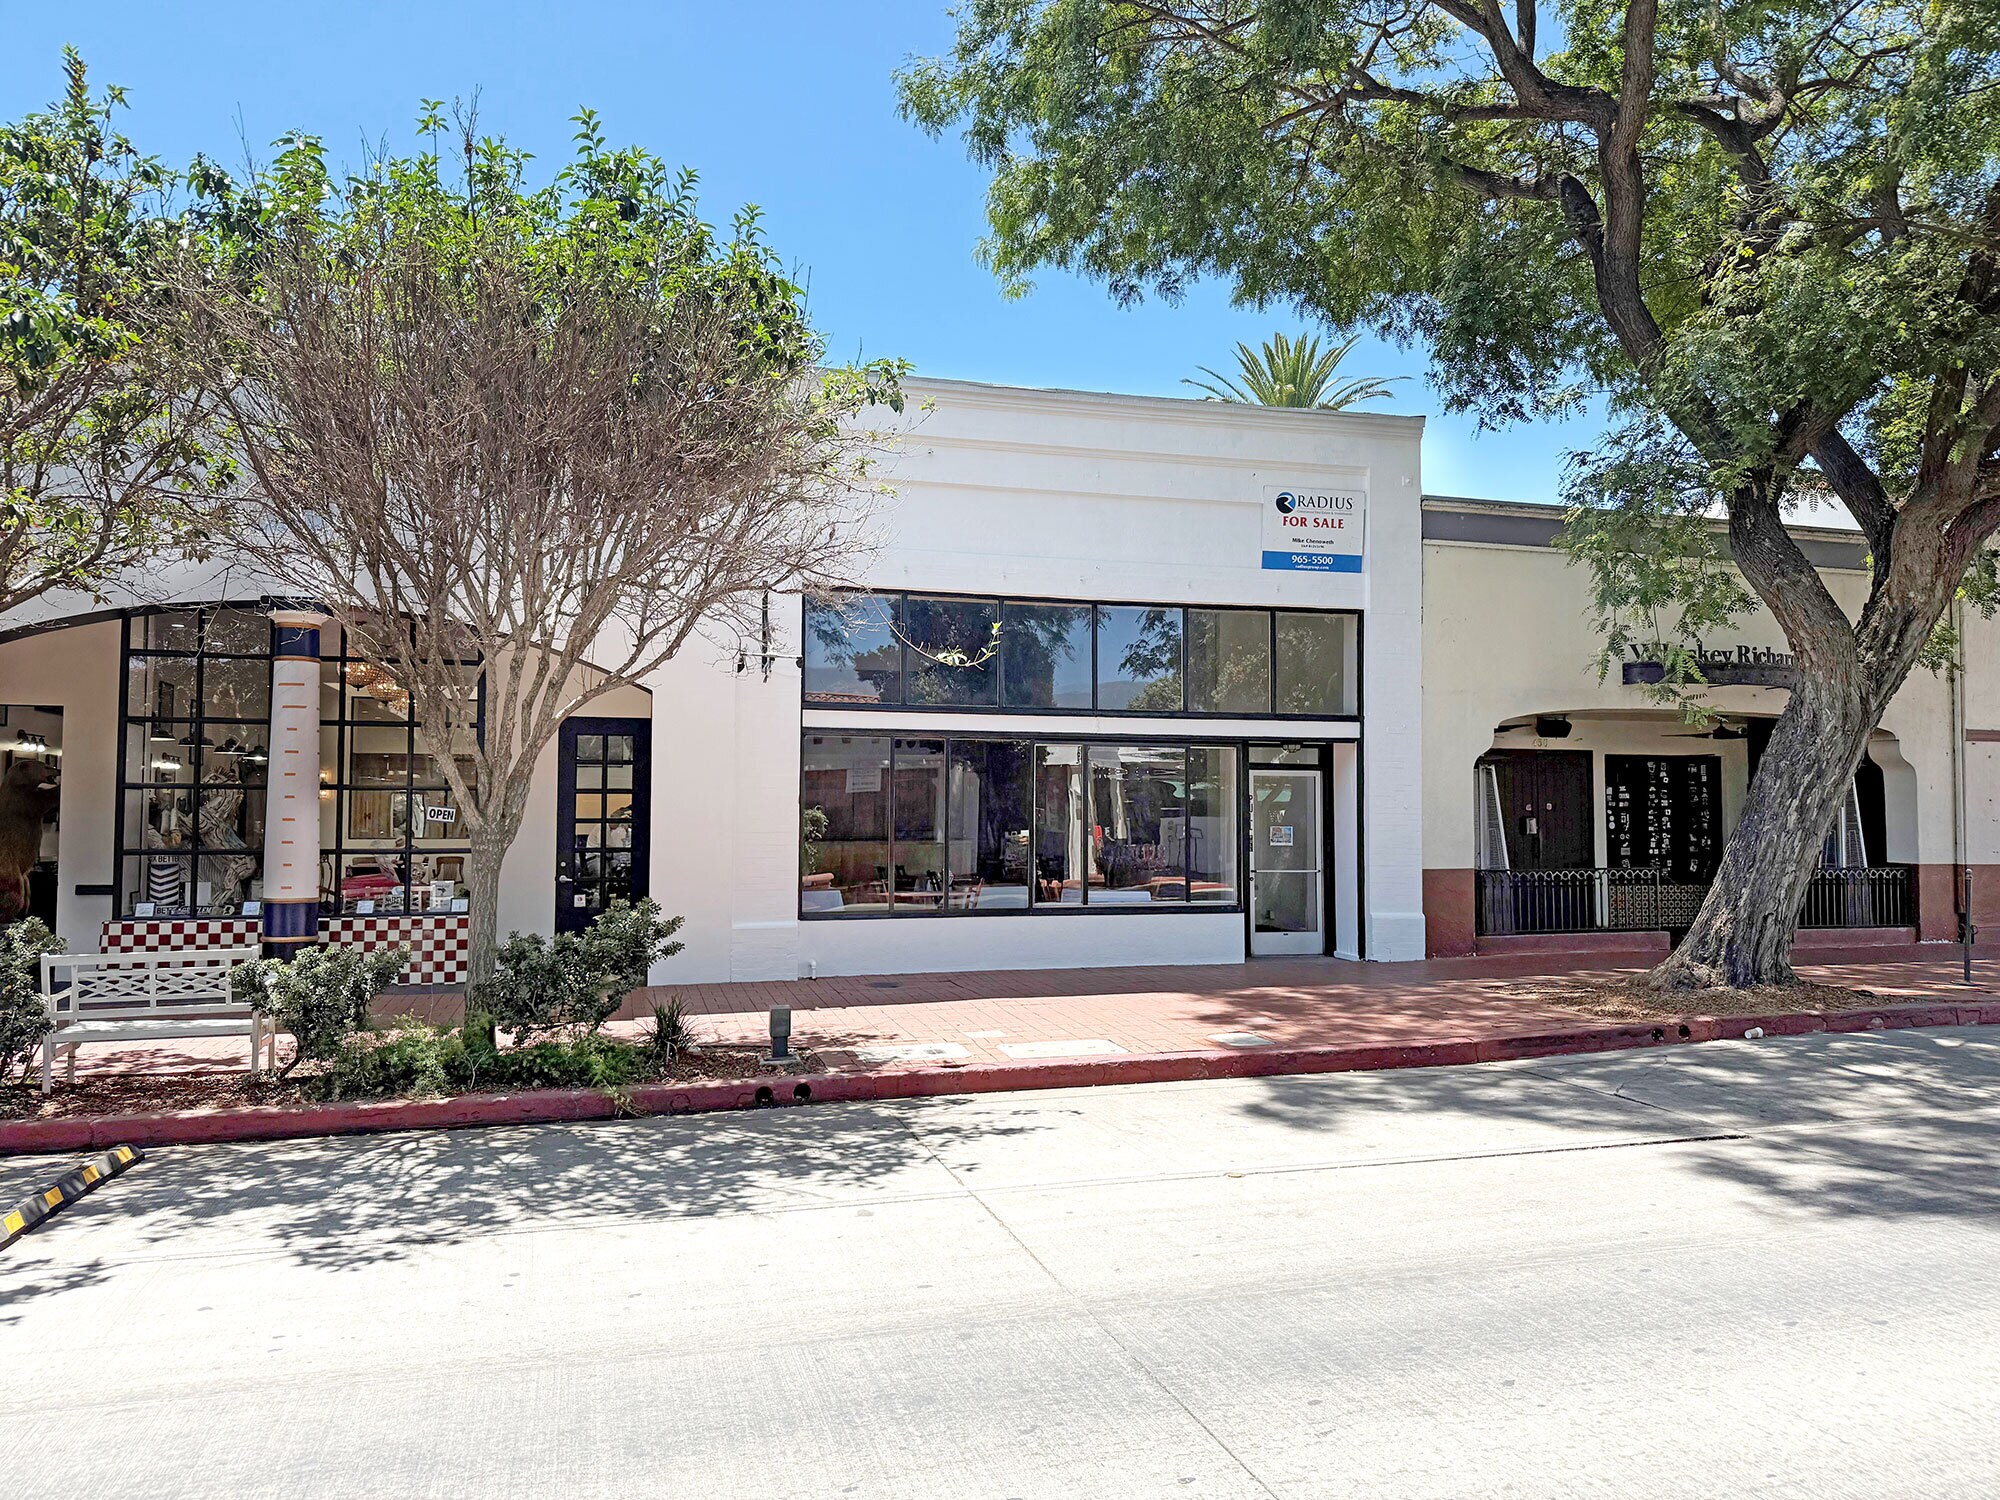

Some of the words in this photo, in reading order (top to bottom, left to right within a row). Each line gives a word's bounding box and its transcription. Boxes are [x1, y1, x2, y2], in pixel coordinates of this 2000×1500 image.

[1297, 495, 1353, 510] RADIUS
[1283, 516, 1308, 527] FOR
[1313, 517, 1345, 529] SALE
[1292, 555, 1333, 565] 965-5500
[1629, 641, 1734, 664] Wkey
[429, 808, 455, 820] OPEN
